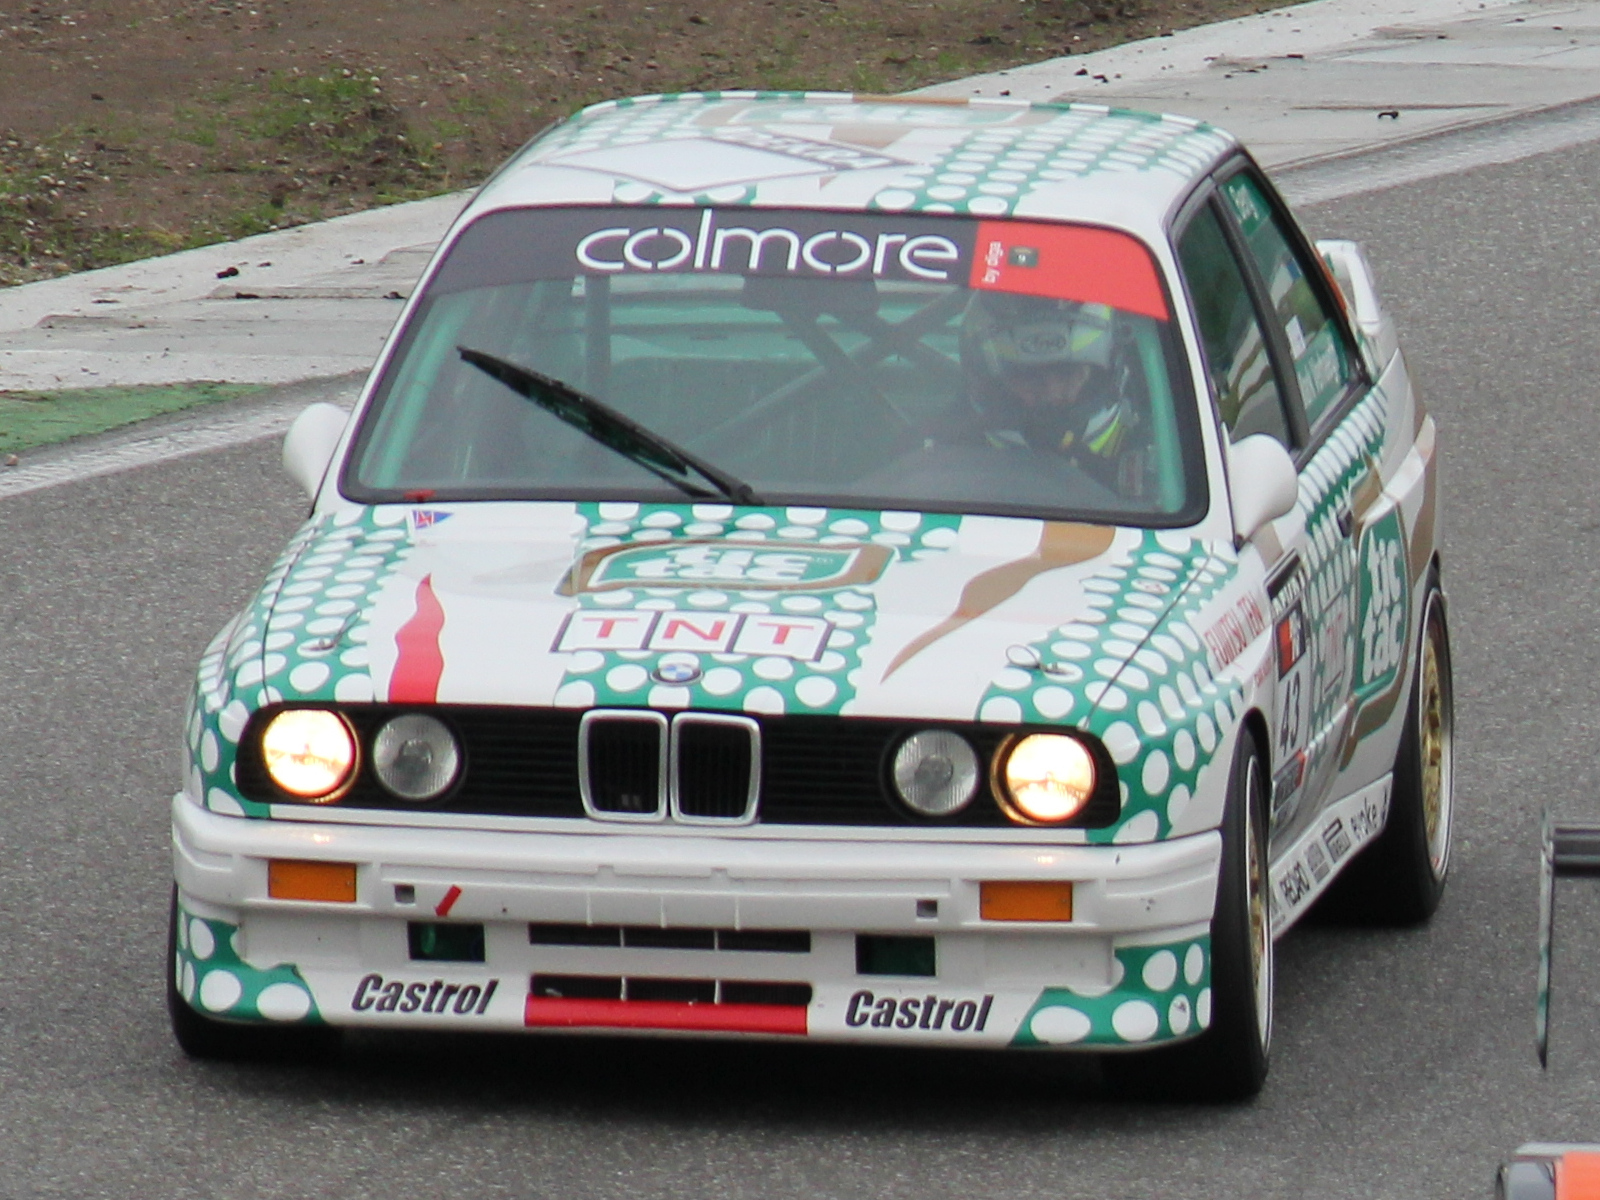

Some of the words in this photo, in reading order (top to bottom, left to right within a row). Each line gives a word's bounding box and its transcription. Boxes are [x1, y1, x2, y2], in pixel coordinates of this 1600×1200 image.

[576, 209, 958, 279] colmore
[1366, 528, 1401, 616] tic
[582, 617, 815, 645] TNT
[1362, 594, 1402, 684] tac
[1279, 670, 1301, 757] 43
[351, 973, 500, 1015] Castrol
[844, 989, 994, 1031] Castrol
